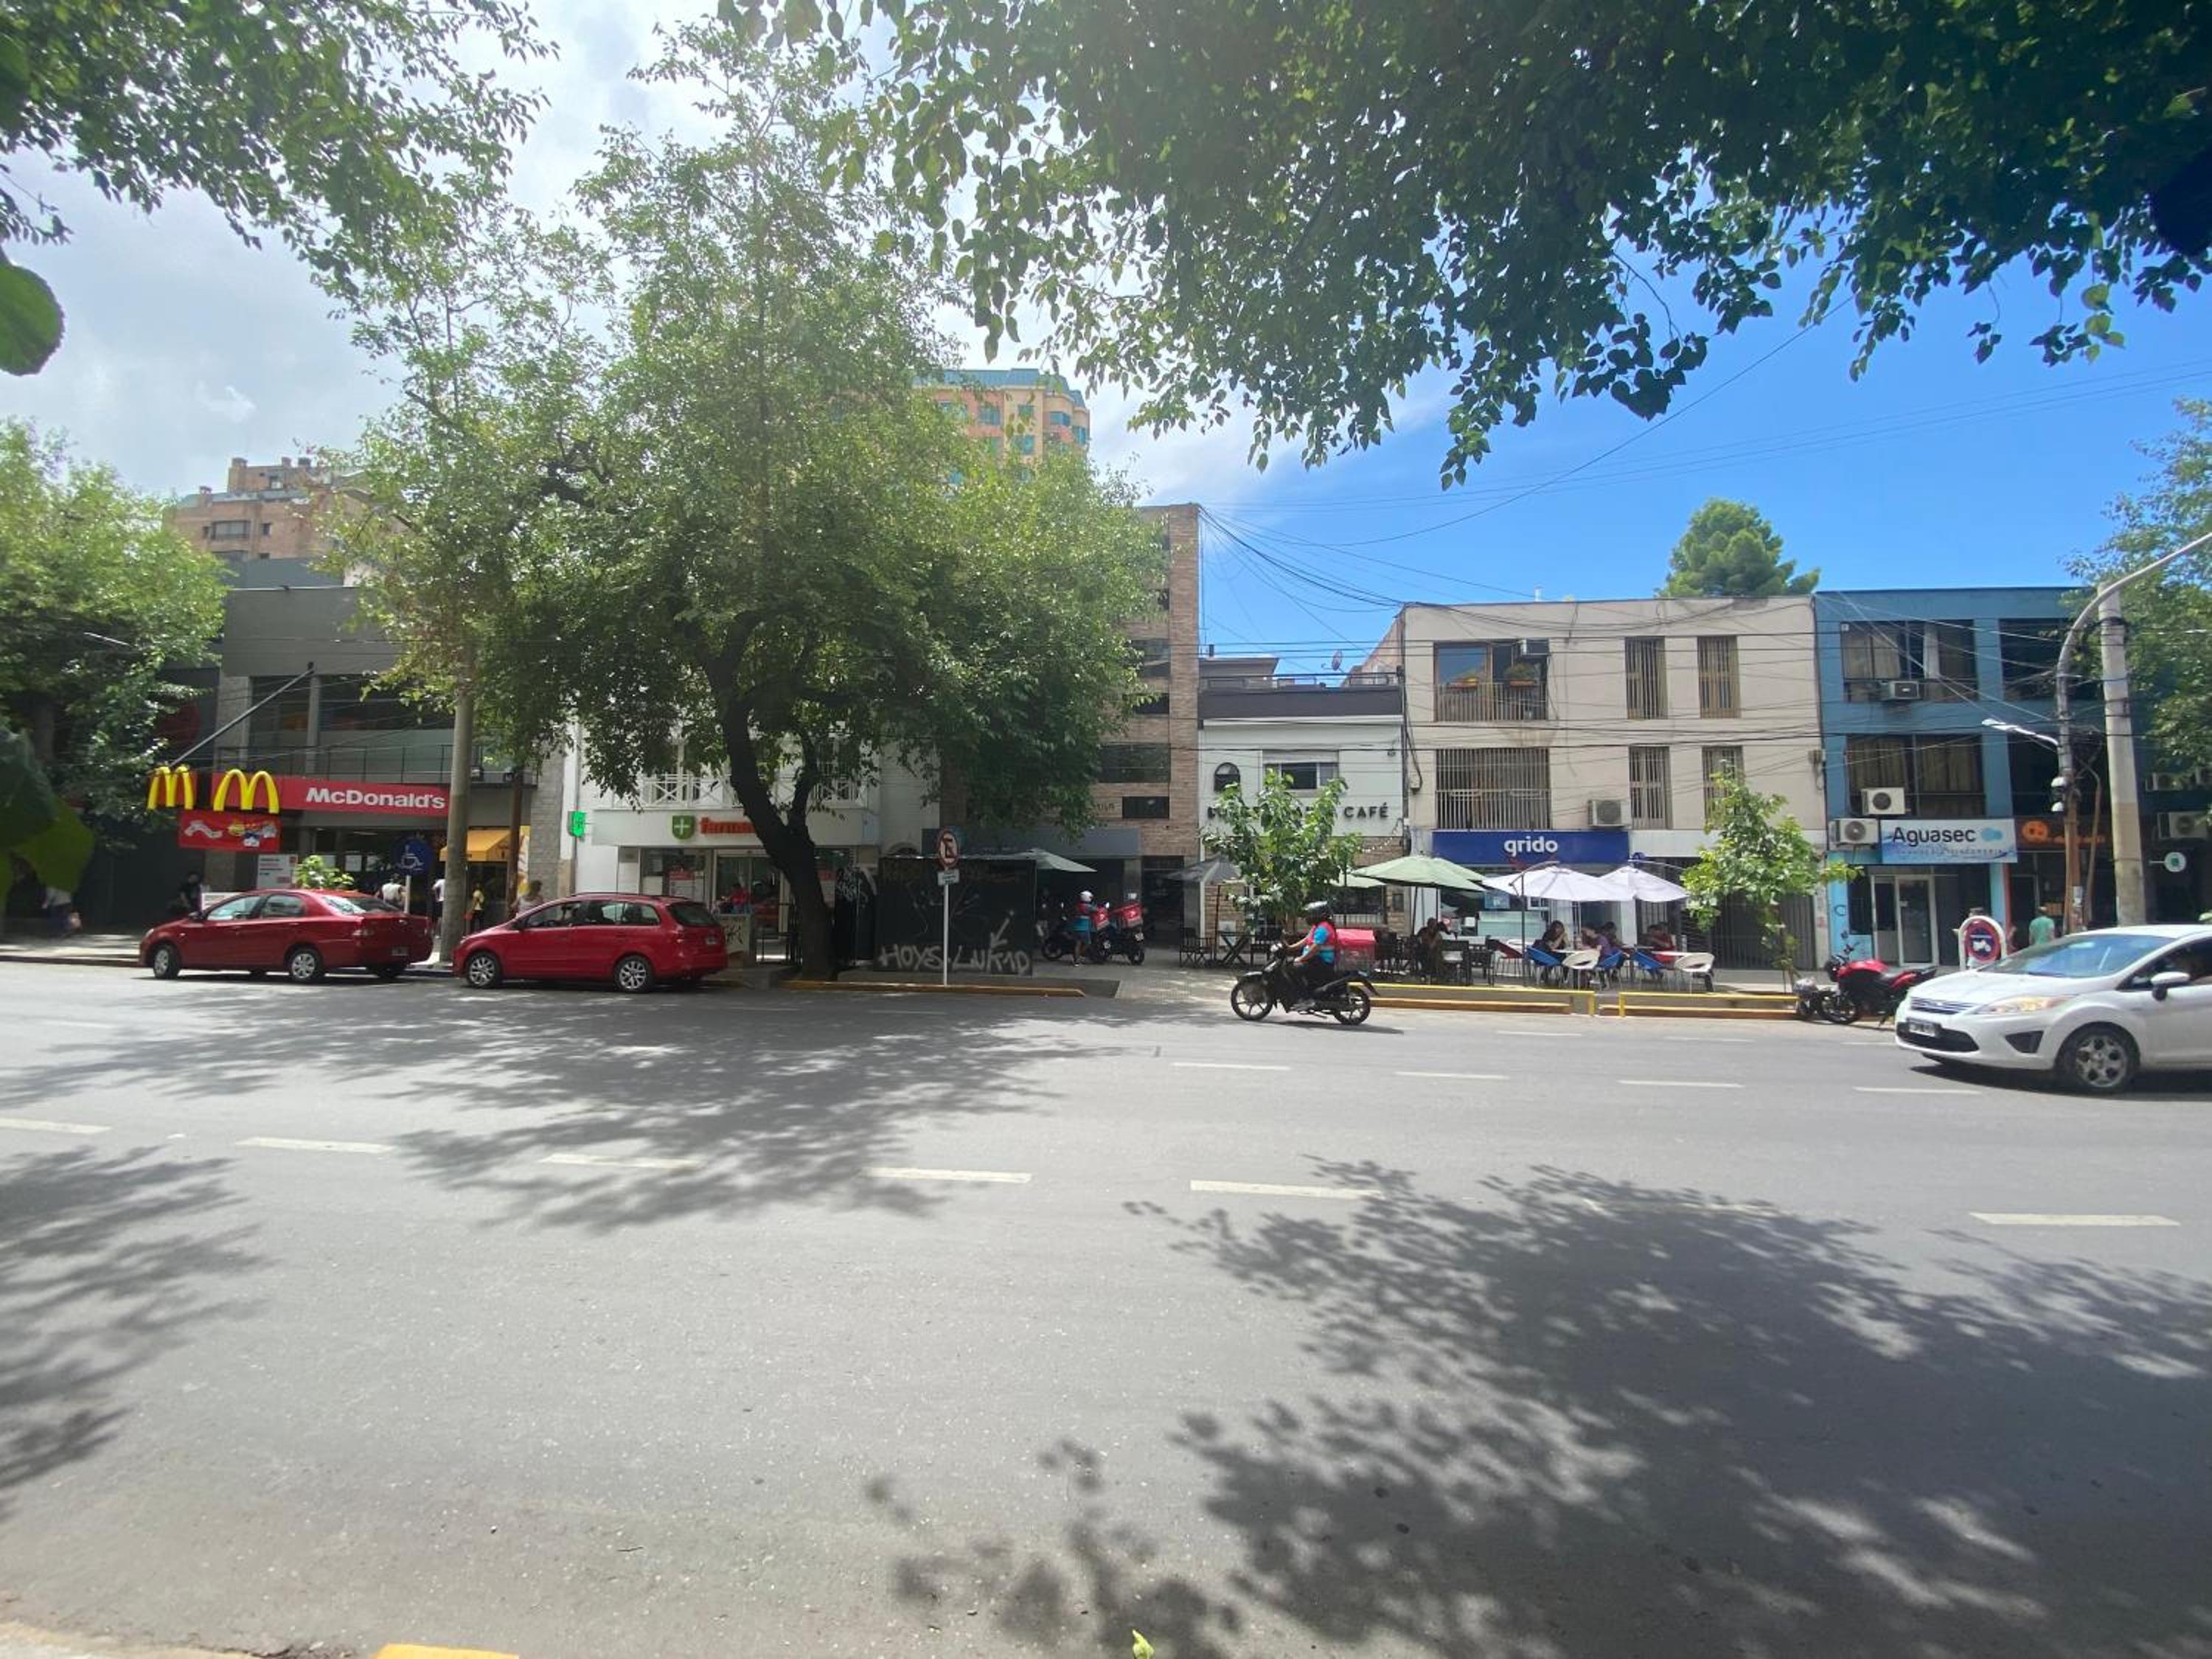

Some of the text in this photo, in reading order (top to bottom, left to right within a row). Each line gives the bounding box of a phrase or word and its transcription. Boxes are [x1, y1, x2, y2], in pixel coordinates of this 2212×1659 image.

[306, 787, 446, 809] McDonald's
[1343, 802, 1388, 819] CAFÉ
[1503, 835, 1558, 857] grido
[1892, 827, 1977, 846] Aguasec
